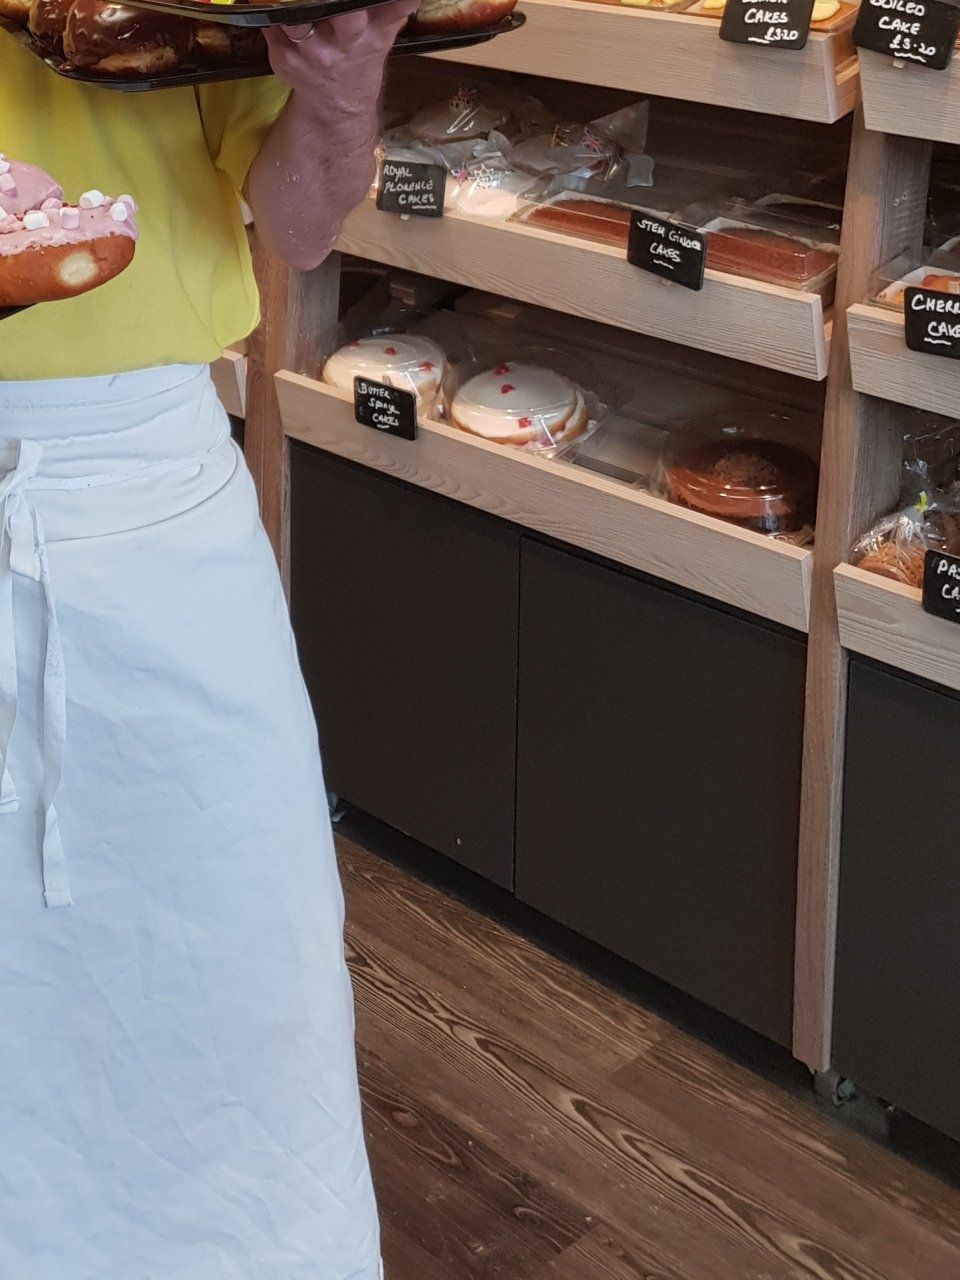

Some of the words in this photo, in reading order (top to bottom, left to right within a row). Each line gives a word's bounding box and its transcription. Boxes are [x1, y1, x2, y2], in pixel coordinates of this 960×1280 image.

[744, 7, 789, 24] CAKES
[878, 16, 922, 36] CAKE
[636, 219, 666, 238] STEM
